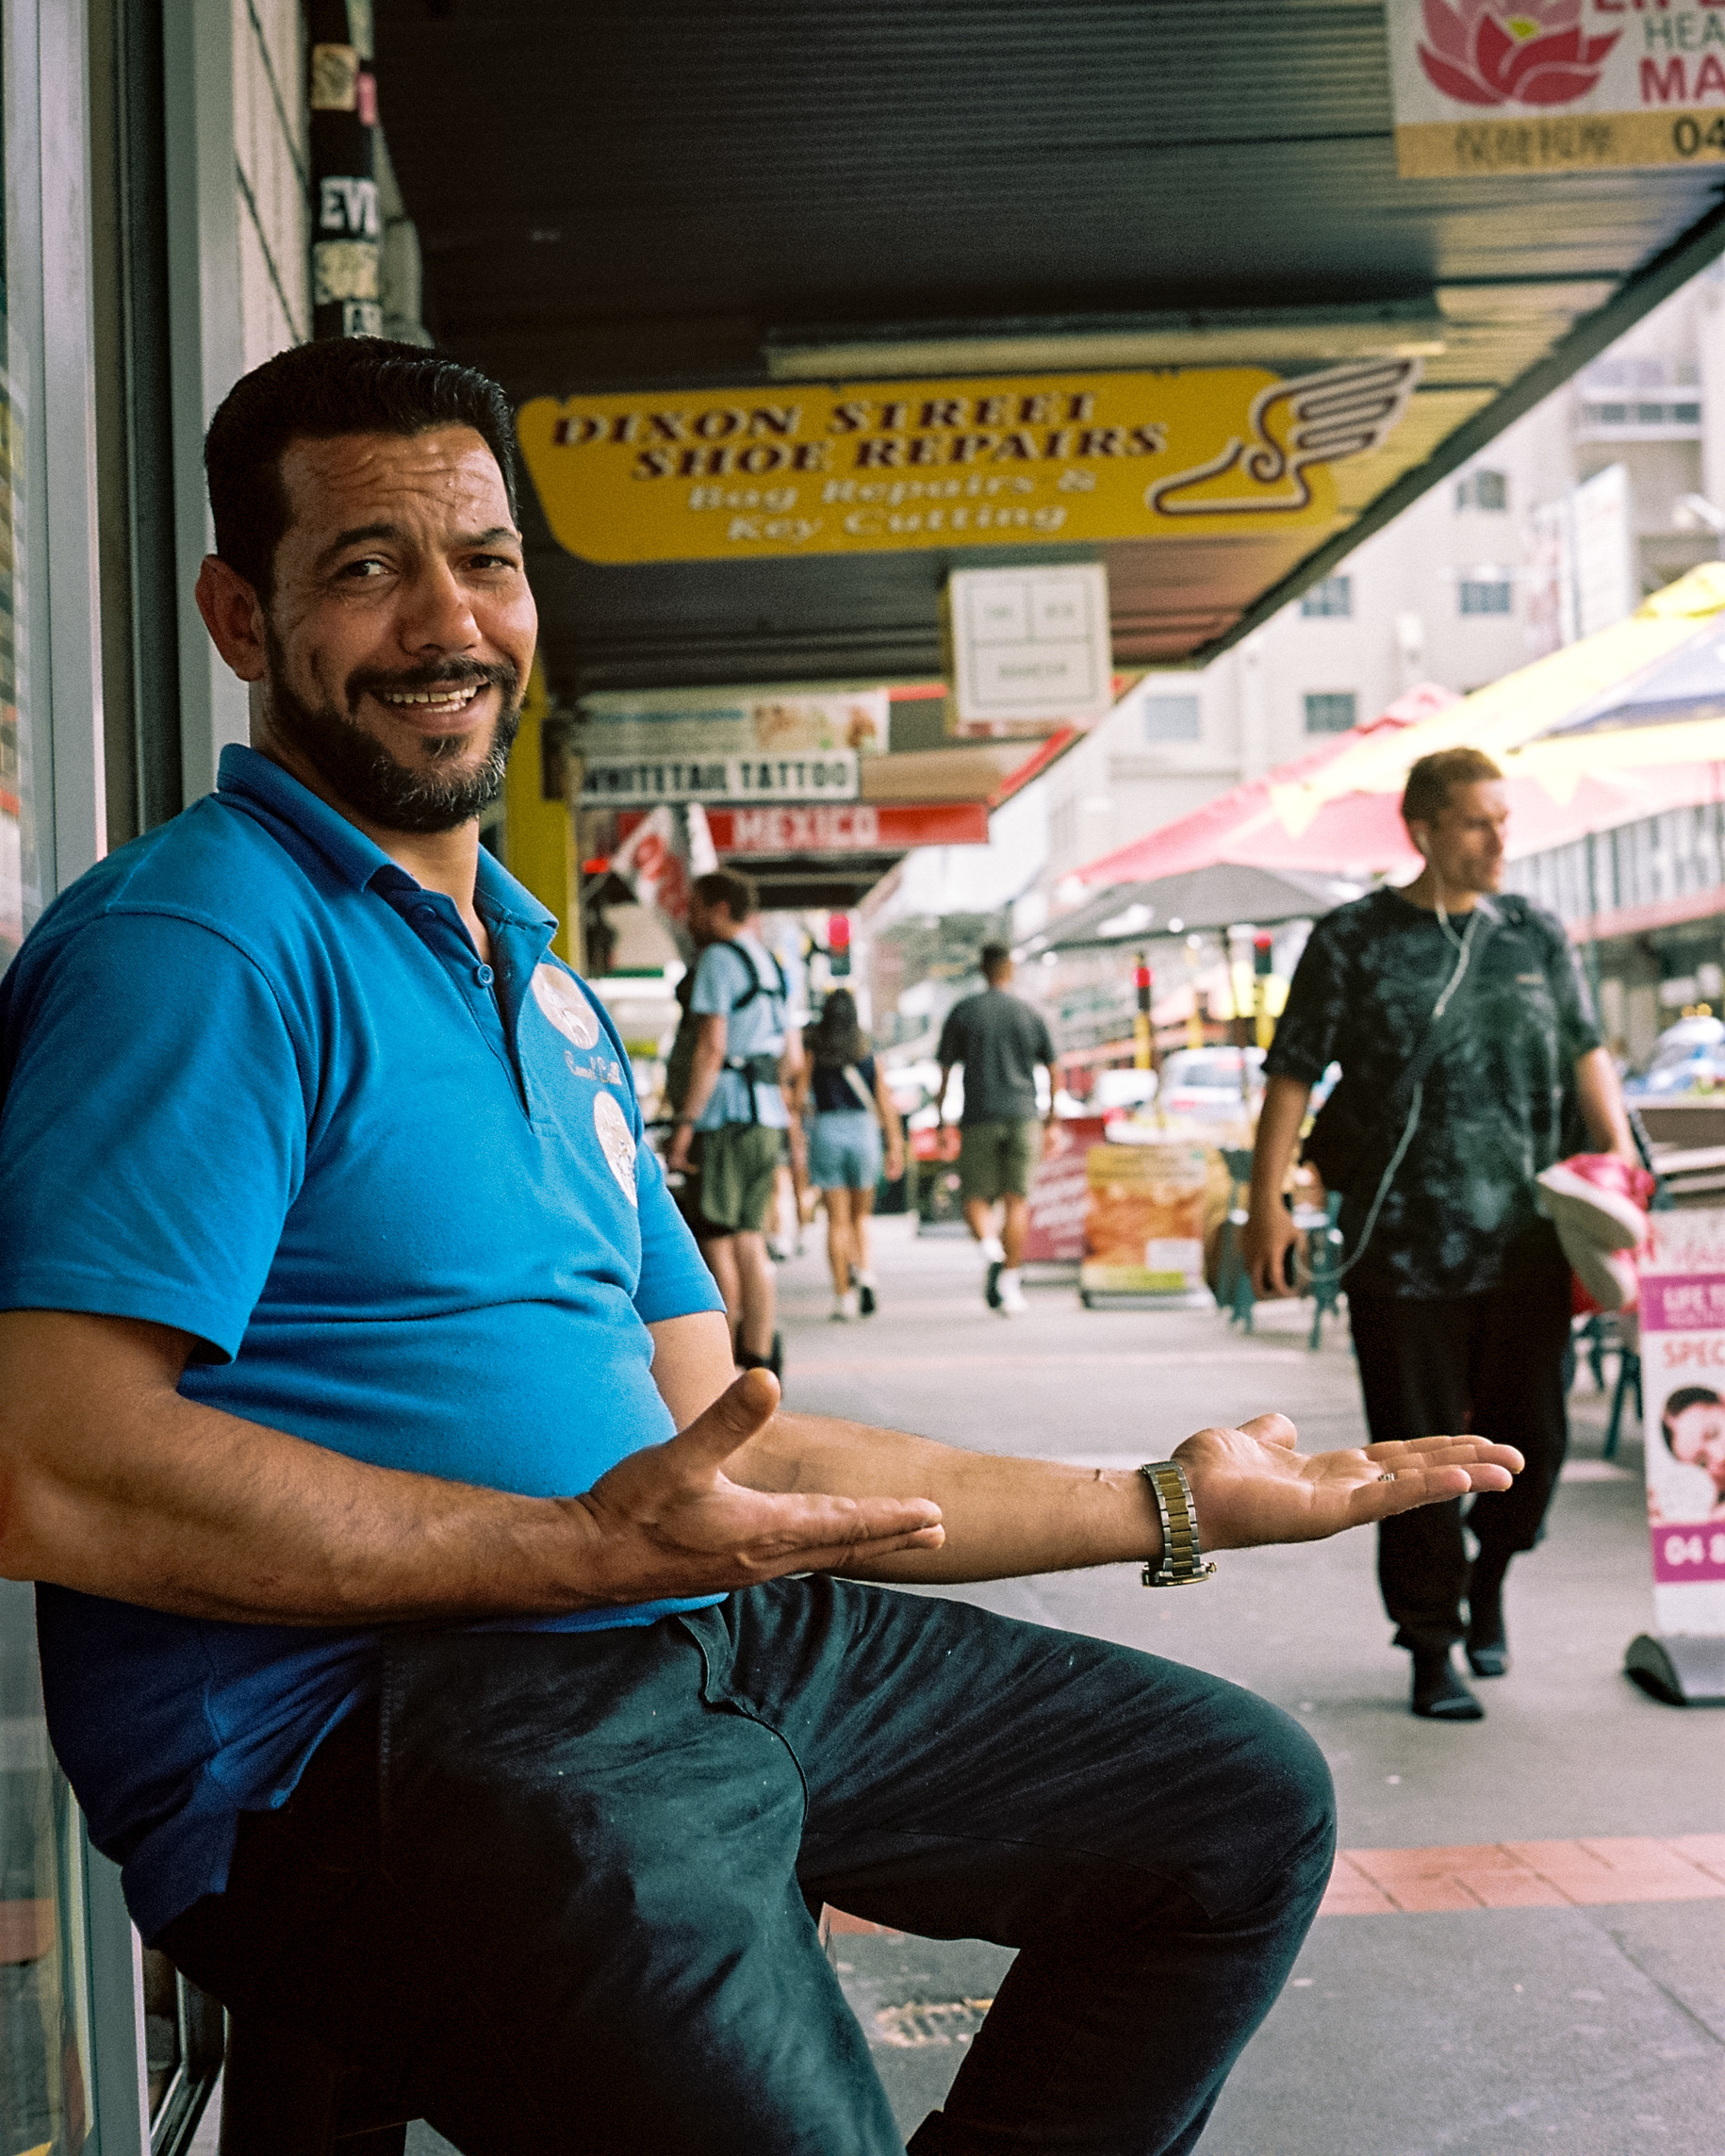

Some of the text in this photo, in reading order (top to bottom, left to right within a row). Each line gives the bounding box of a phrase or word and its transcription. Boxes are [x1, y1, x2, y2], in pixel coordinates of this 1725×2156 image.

[551, 390, 1096, 447] DIXON STREET
[630, 420, 1171, 482] SHOE REPAIRS
[688, 469, 1097, 514] Bag Repairs &
[727, 502, 1068, 545] Key Cutting
[740, 761, 847, 790] TATTOO
[731, 806, 879, 848] MEXICO
